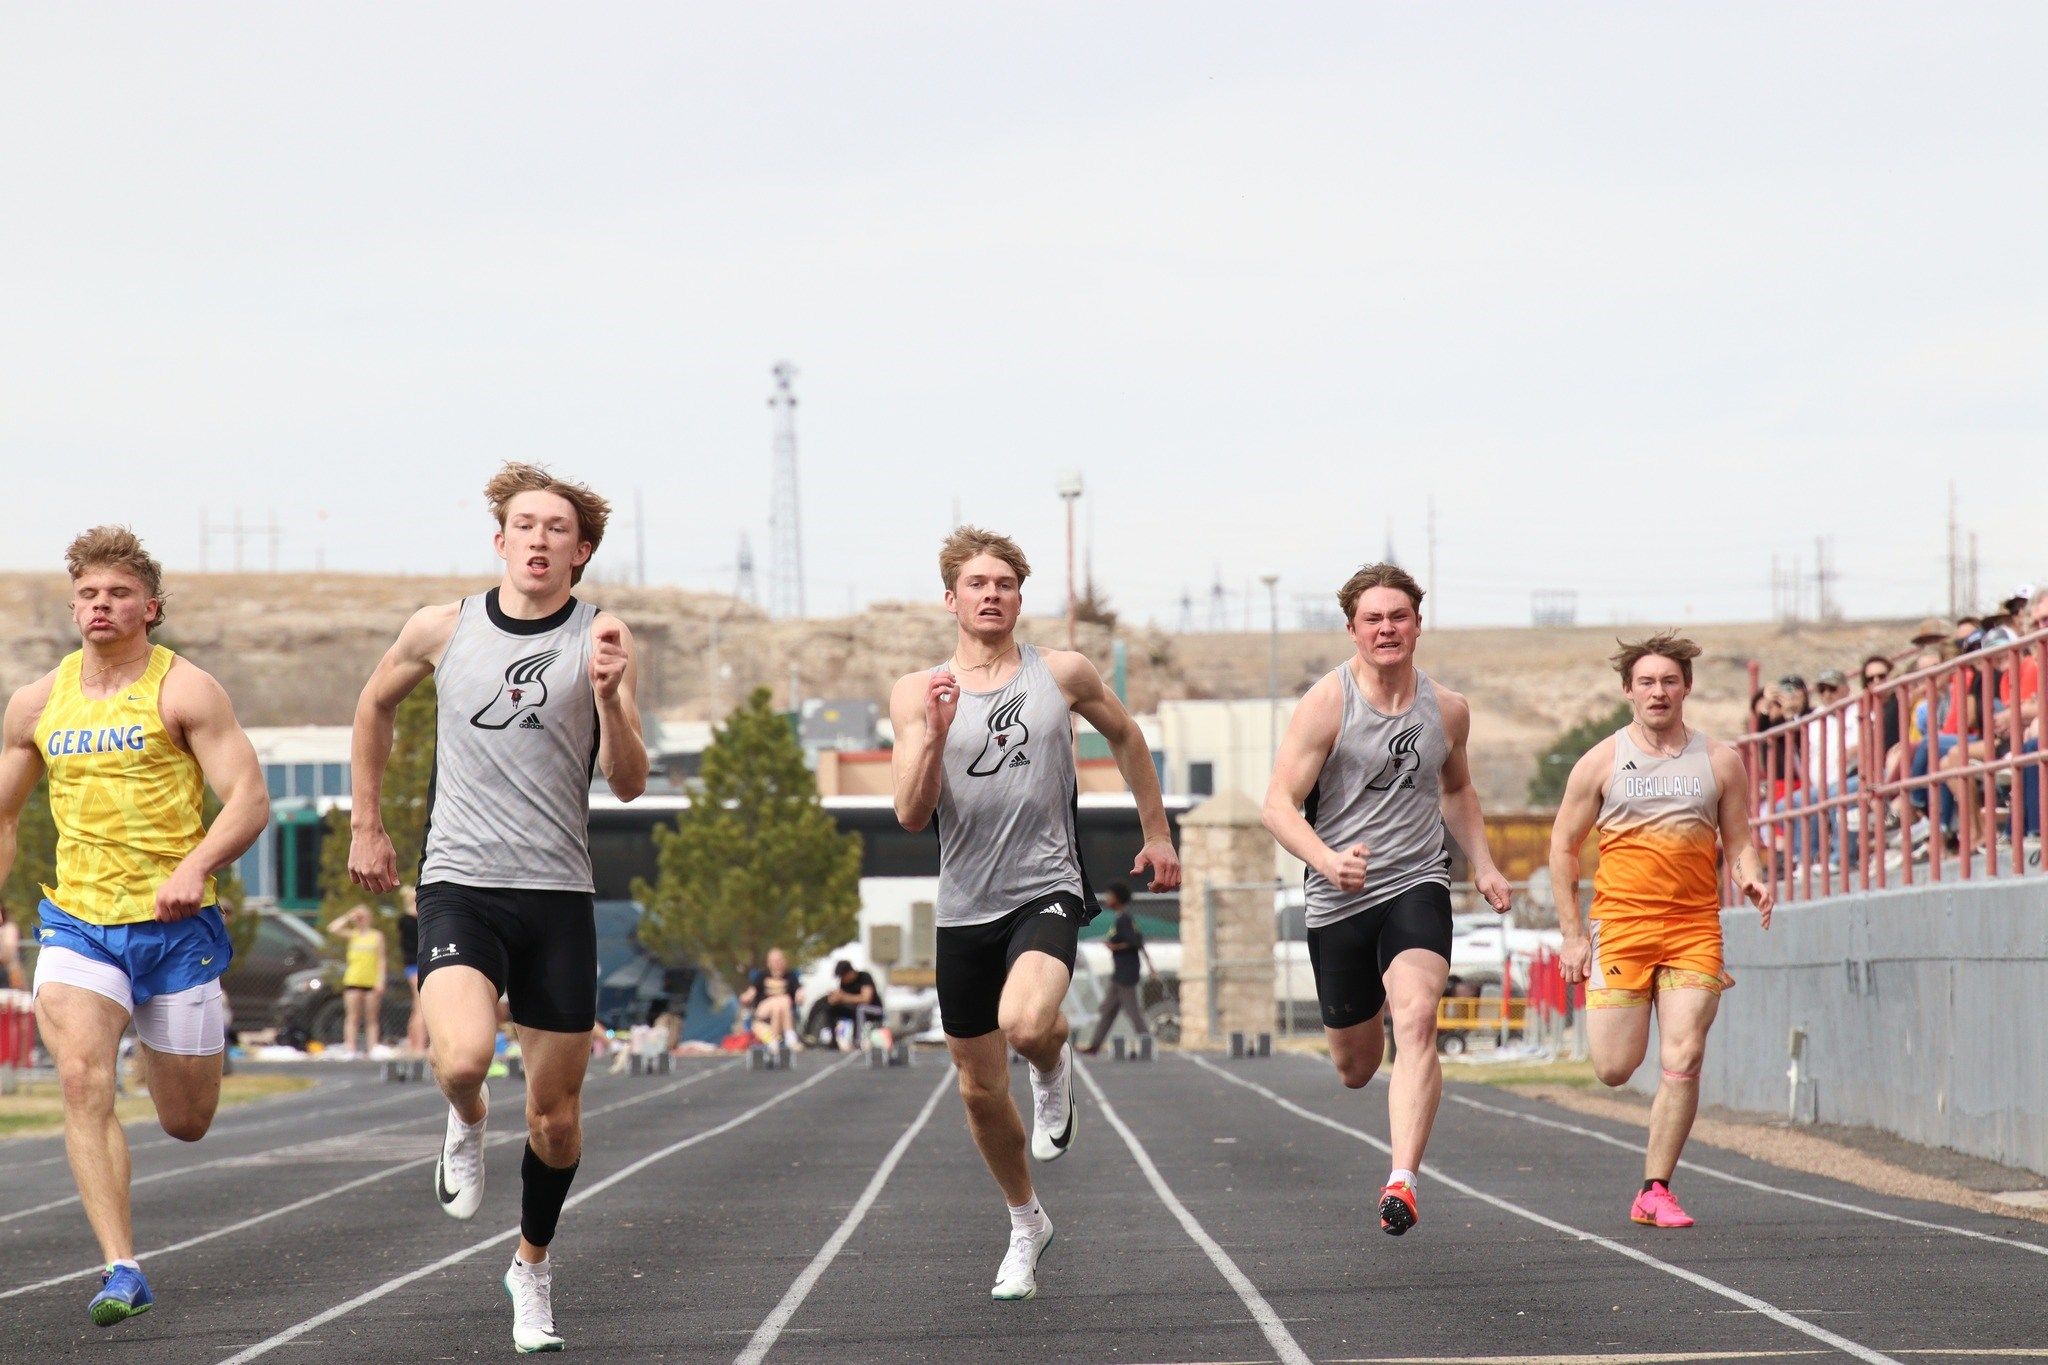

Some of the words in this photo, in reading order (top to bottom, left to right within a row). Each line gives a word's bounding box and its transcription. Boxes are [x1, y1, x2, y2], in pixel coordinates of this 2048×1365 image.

[518, 722, 545, 730] adidas
[47, 724, 145, 757] GERING
[1009, 759, 1031, 769] adidas
[1625, 776, 1703, 798] OGALLALA
